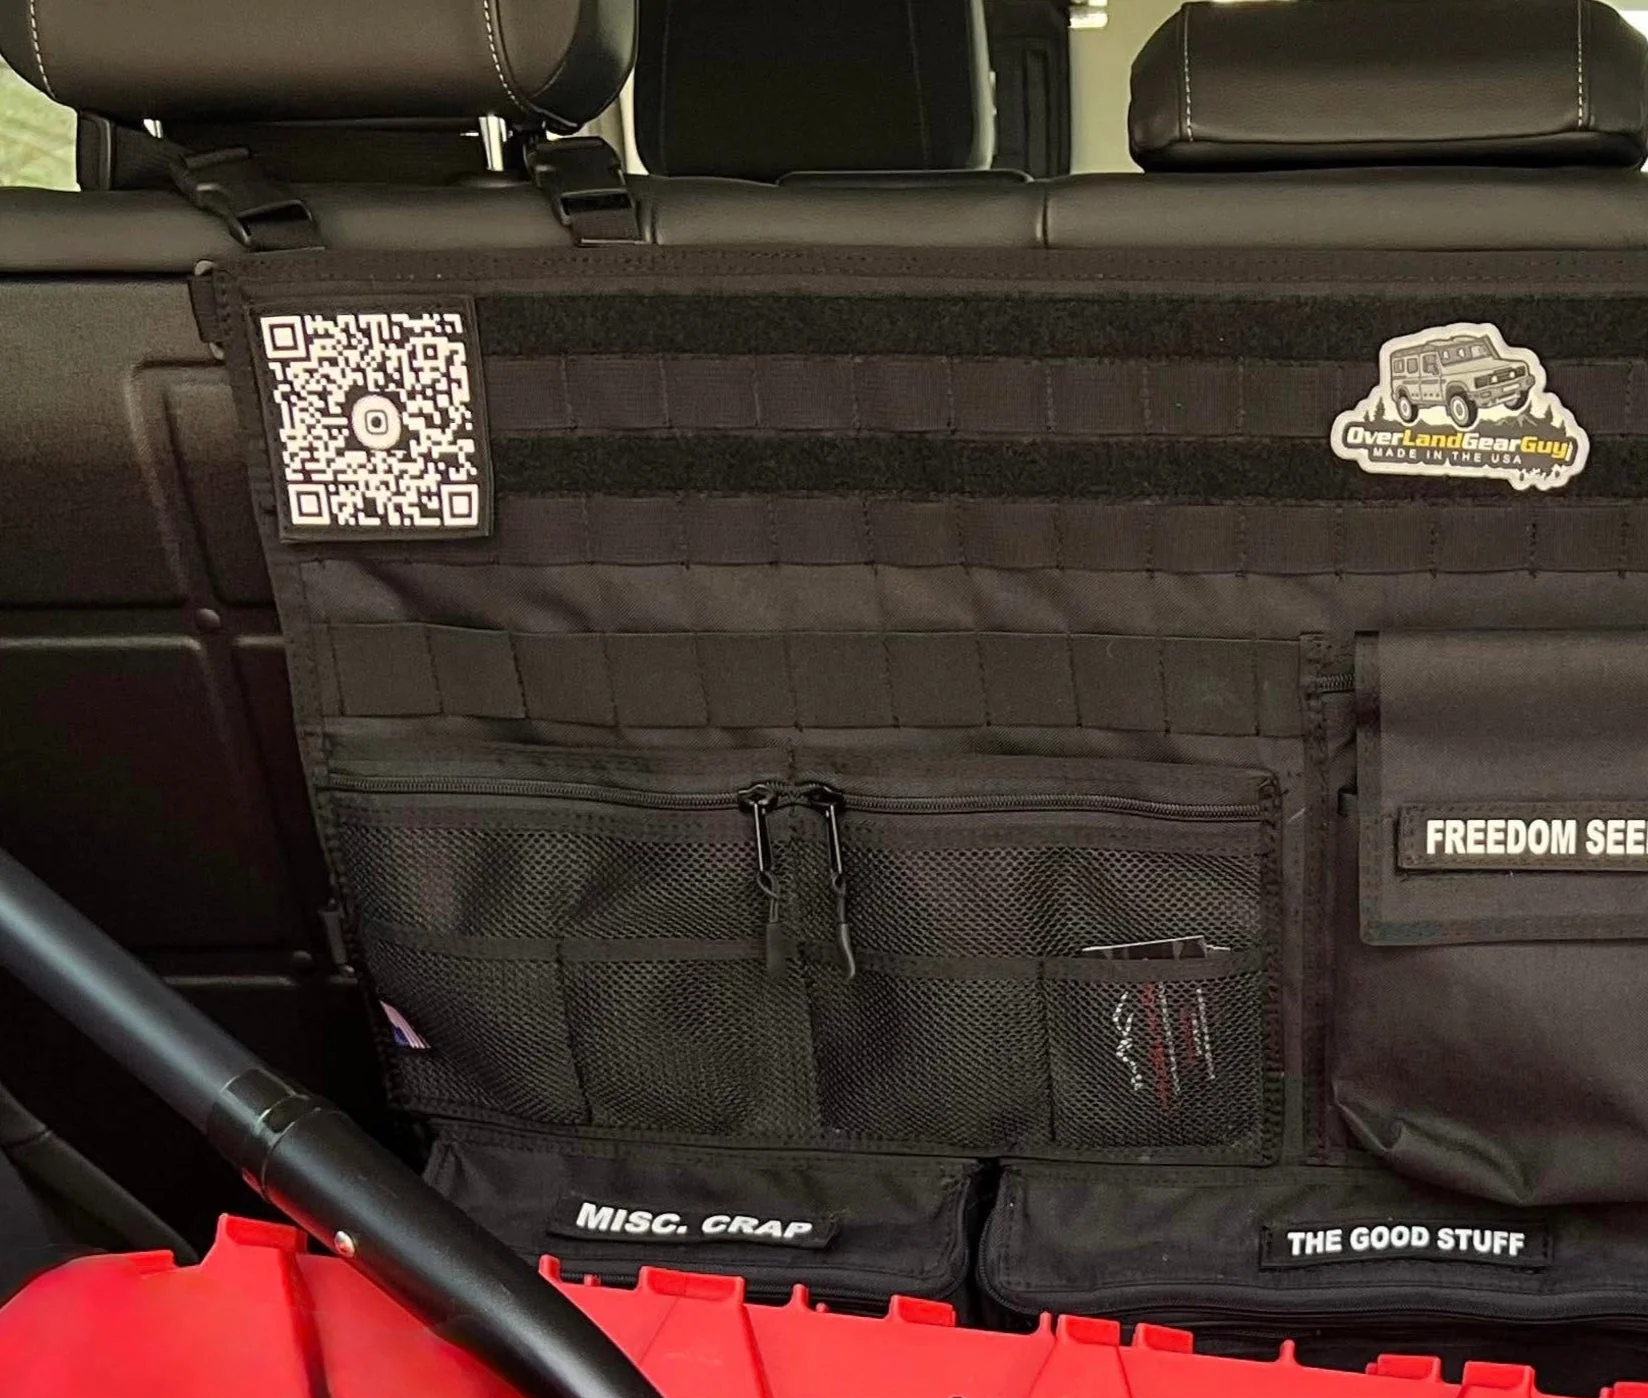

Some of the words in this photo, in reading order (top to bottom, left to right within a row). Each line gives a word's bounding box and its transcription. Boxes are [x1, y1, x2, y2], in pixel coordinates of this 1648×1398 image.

[1346, 426, 1568, 460] OverLandGearGuy
[1372, 447, 1417, 459] MADE
[1426, 449, 1442, 461] IN
[1452, 450, 1481, 463] THE
[1491, 452, 1522, 465] USA
[1425, 819, 1577, 856] FREEDOM
[575, 1202, 689, 1235] MISC.
[701, 1214, 813, 1239] CRAP
[1287, 1228, 1343, 1256] THE
[1350, 1225, 1430, 1250] GOOD
[1436, 1227, 1526, 1256] STUFF
